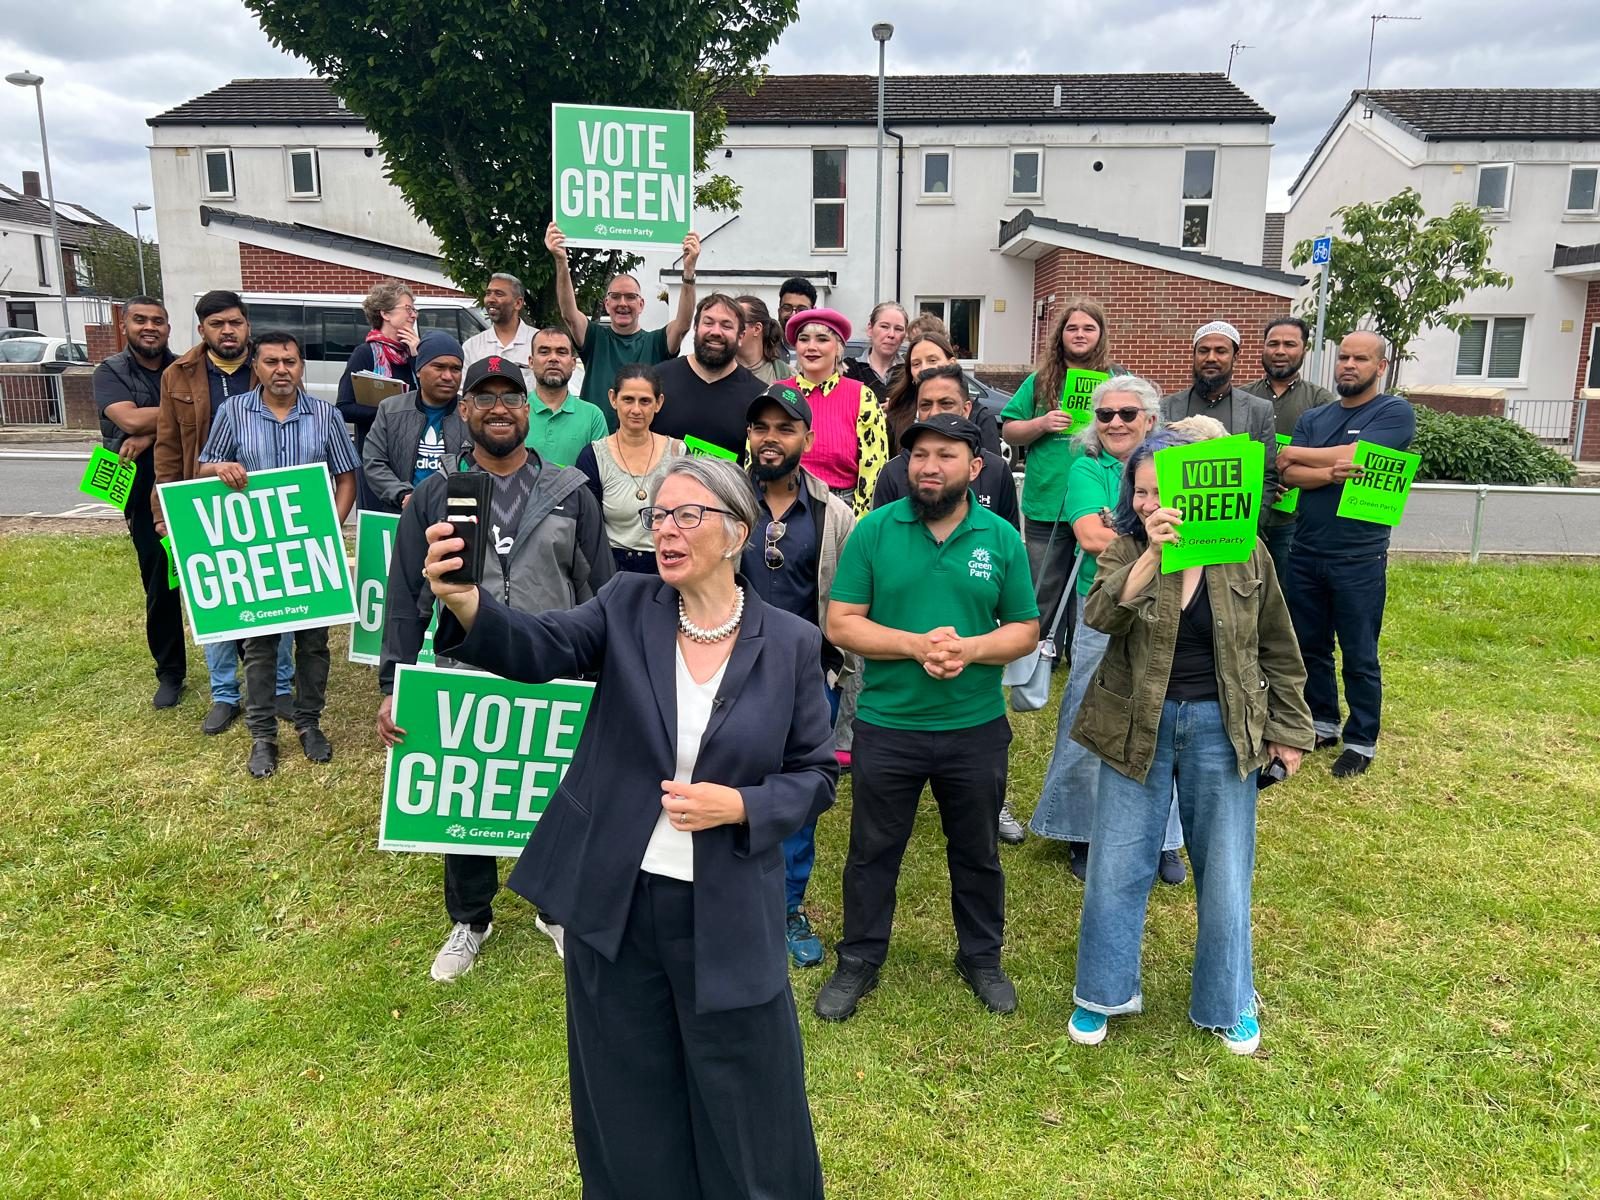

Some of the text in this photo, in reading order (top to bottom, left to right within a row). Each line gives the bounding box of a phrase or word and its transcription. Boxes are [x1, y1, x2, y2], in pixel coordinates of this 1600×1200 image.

[578, 120, 668, 169] VOTE
[560, 168, 685, 223] GREEN
[609, 226, 654, 238] Green Party
[1066, 394, 1092, 411] GRE
[1368, 453, 1404, 471] VOTE
[92, 459, 117, 489] VOTE
[1185, 460, 1240, 487] VOTE
[192, 484, 309, 547] VOTE
[1359, 500, 1398, 513] Green Party
[1219, 536, 1247, 545] Party
[186, 535, 343, 610] GREEN
[968, 560, 992, 571] Green
[969, 568, 991, 581] Party
[256, 604, 309, 619] Green Party
[437, 690, 582, 758] VOTE
[396, 752, 571, 822] GREE
[469, 828, 531, 839] Green Part
